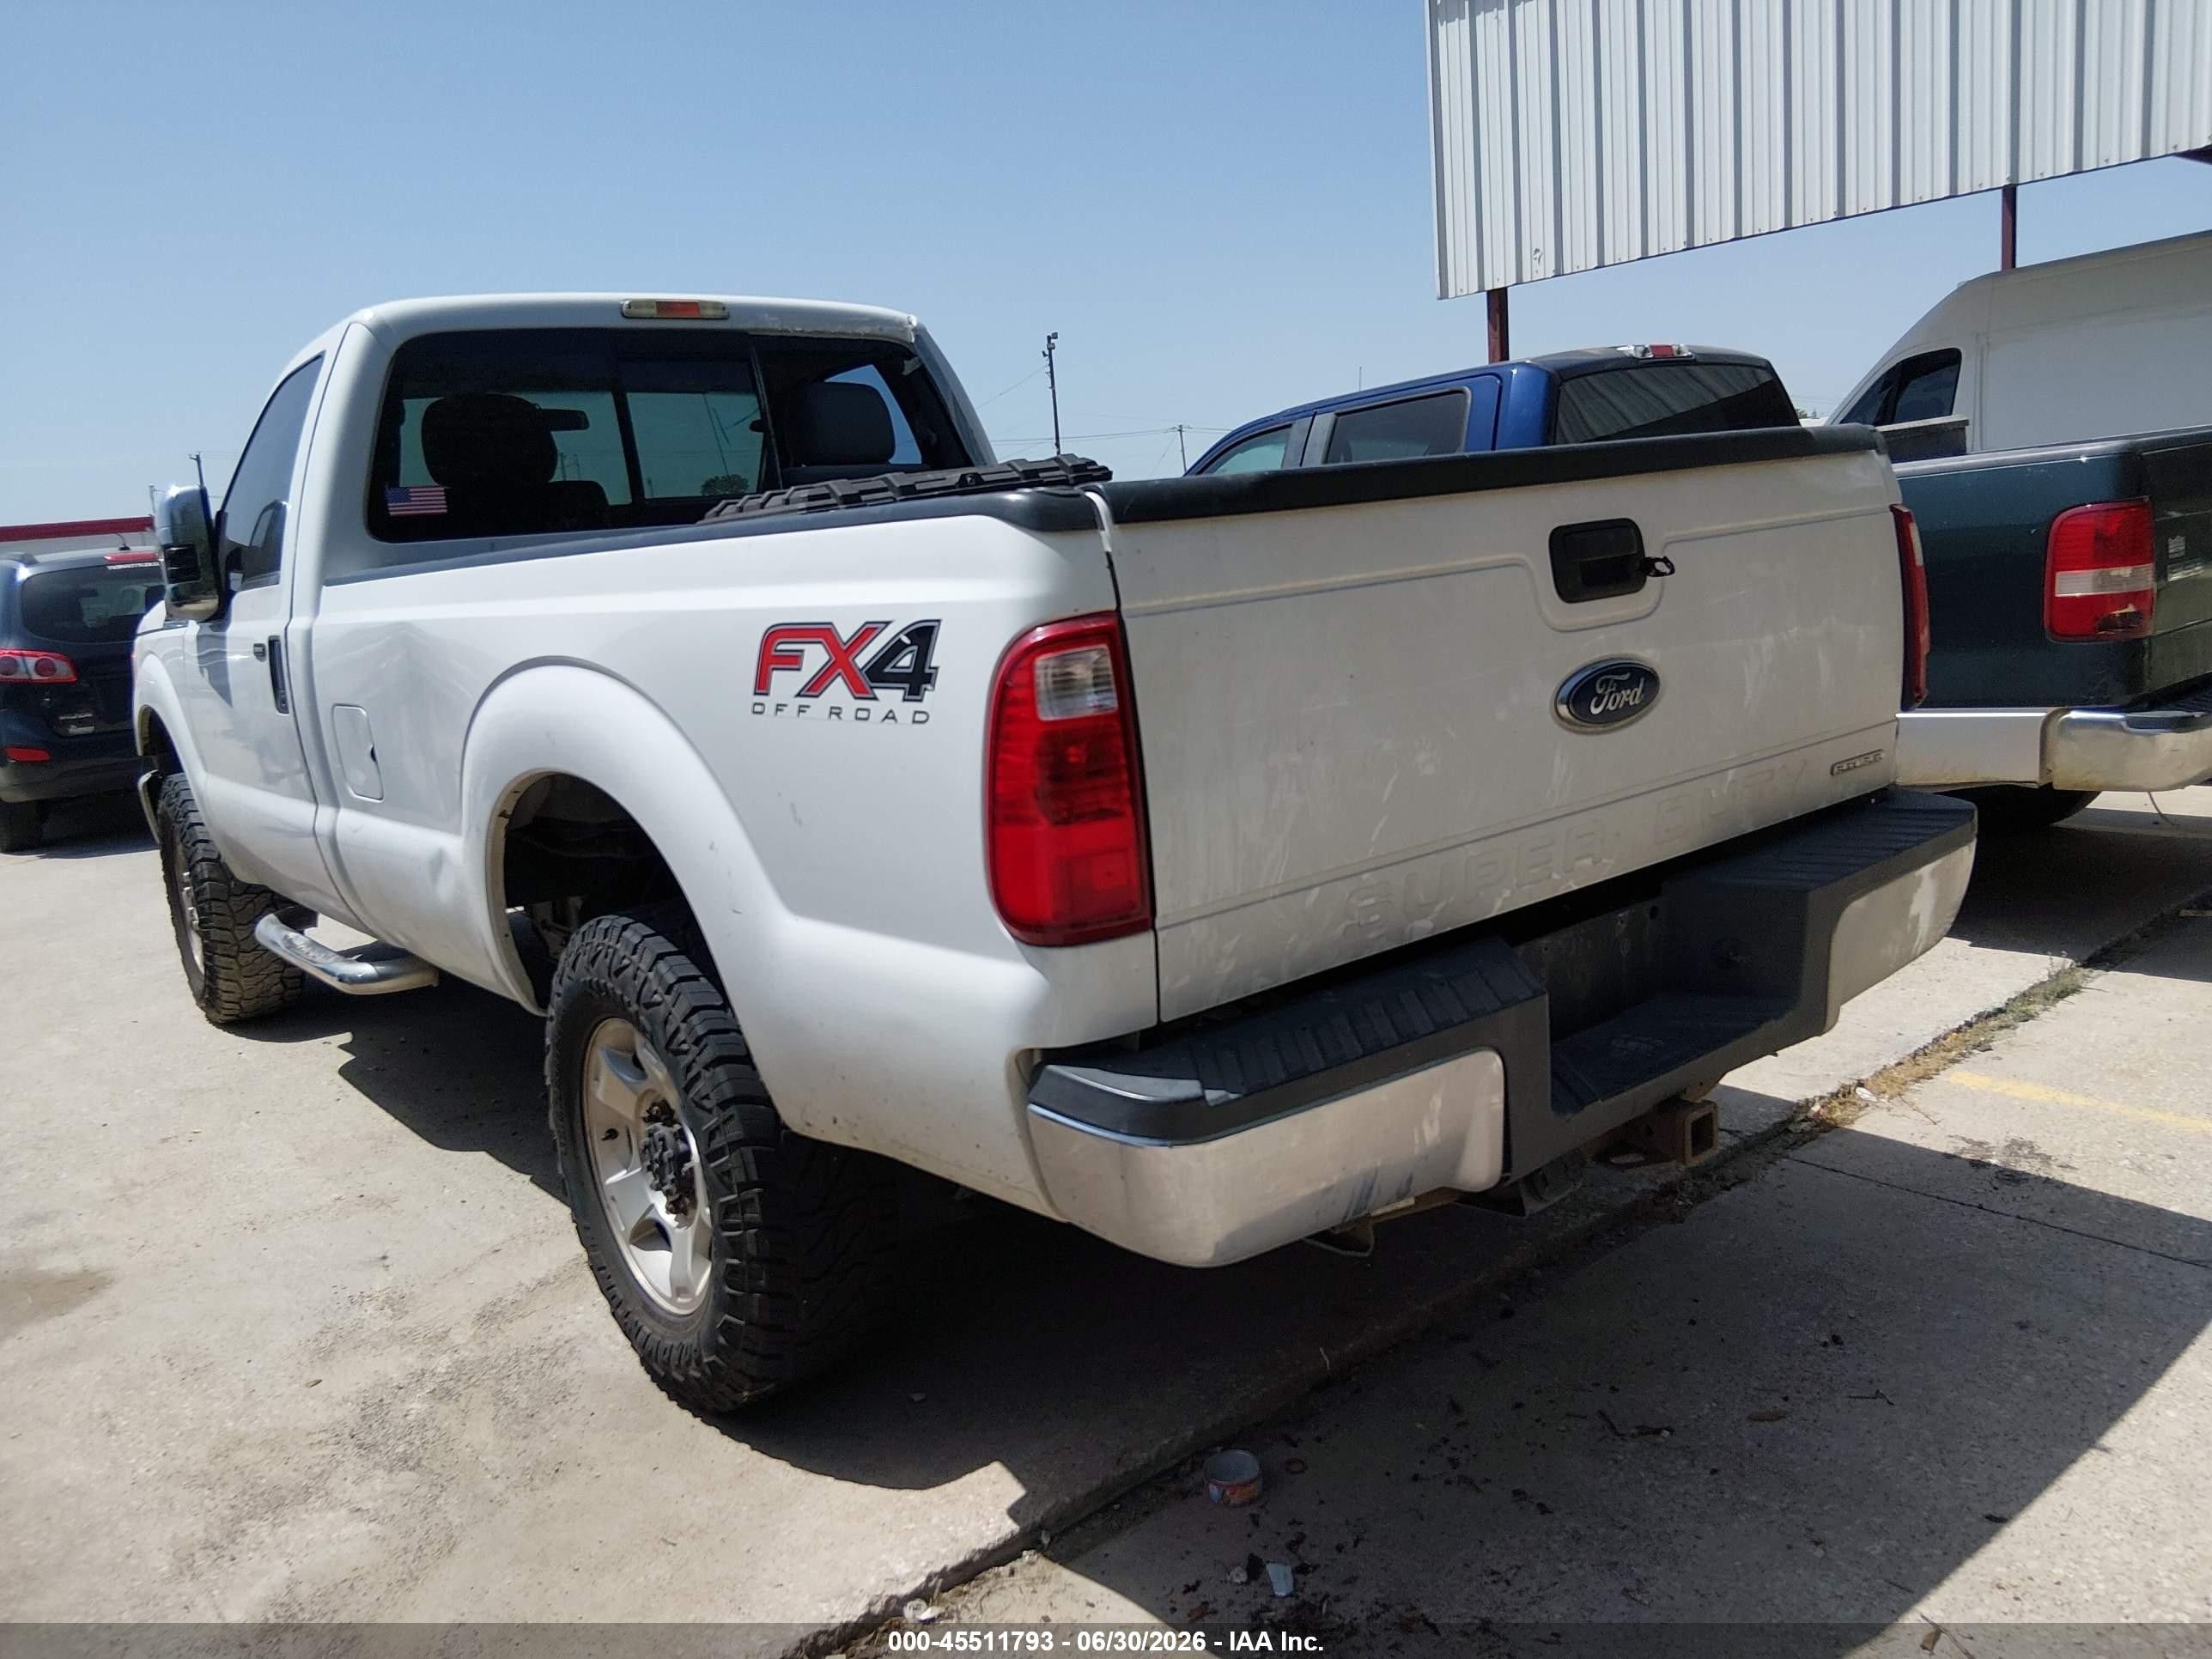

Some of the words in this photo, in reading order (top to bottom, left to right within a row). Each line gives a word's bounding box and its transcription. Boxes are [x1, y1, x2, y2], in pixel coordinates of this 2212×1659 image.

[753, 619, 943, 702] FX4
[750, 702, 811, 718] OFF
[828, 706, 931, 725] ROAD
[1589, 672, 1645, 715] Ford
[1341, 819, 1613, 945] SUPER
